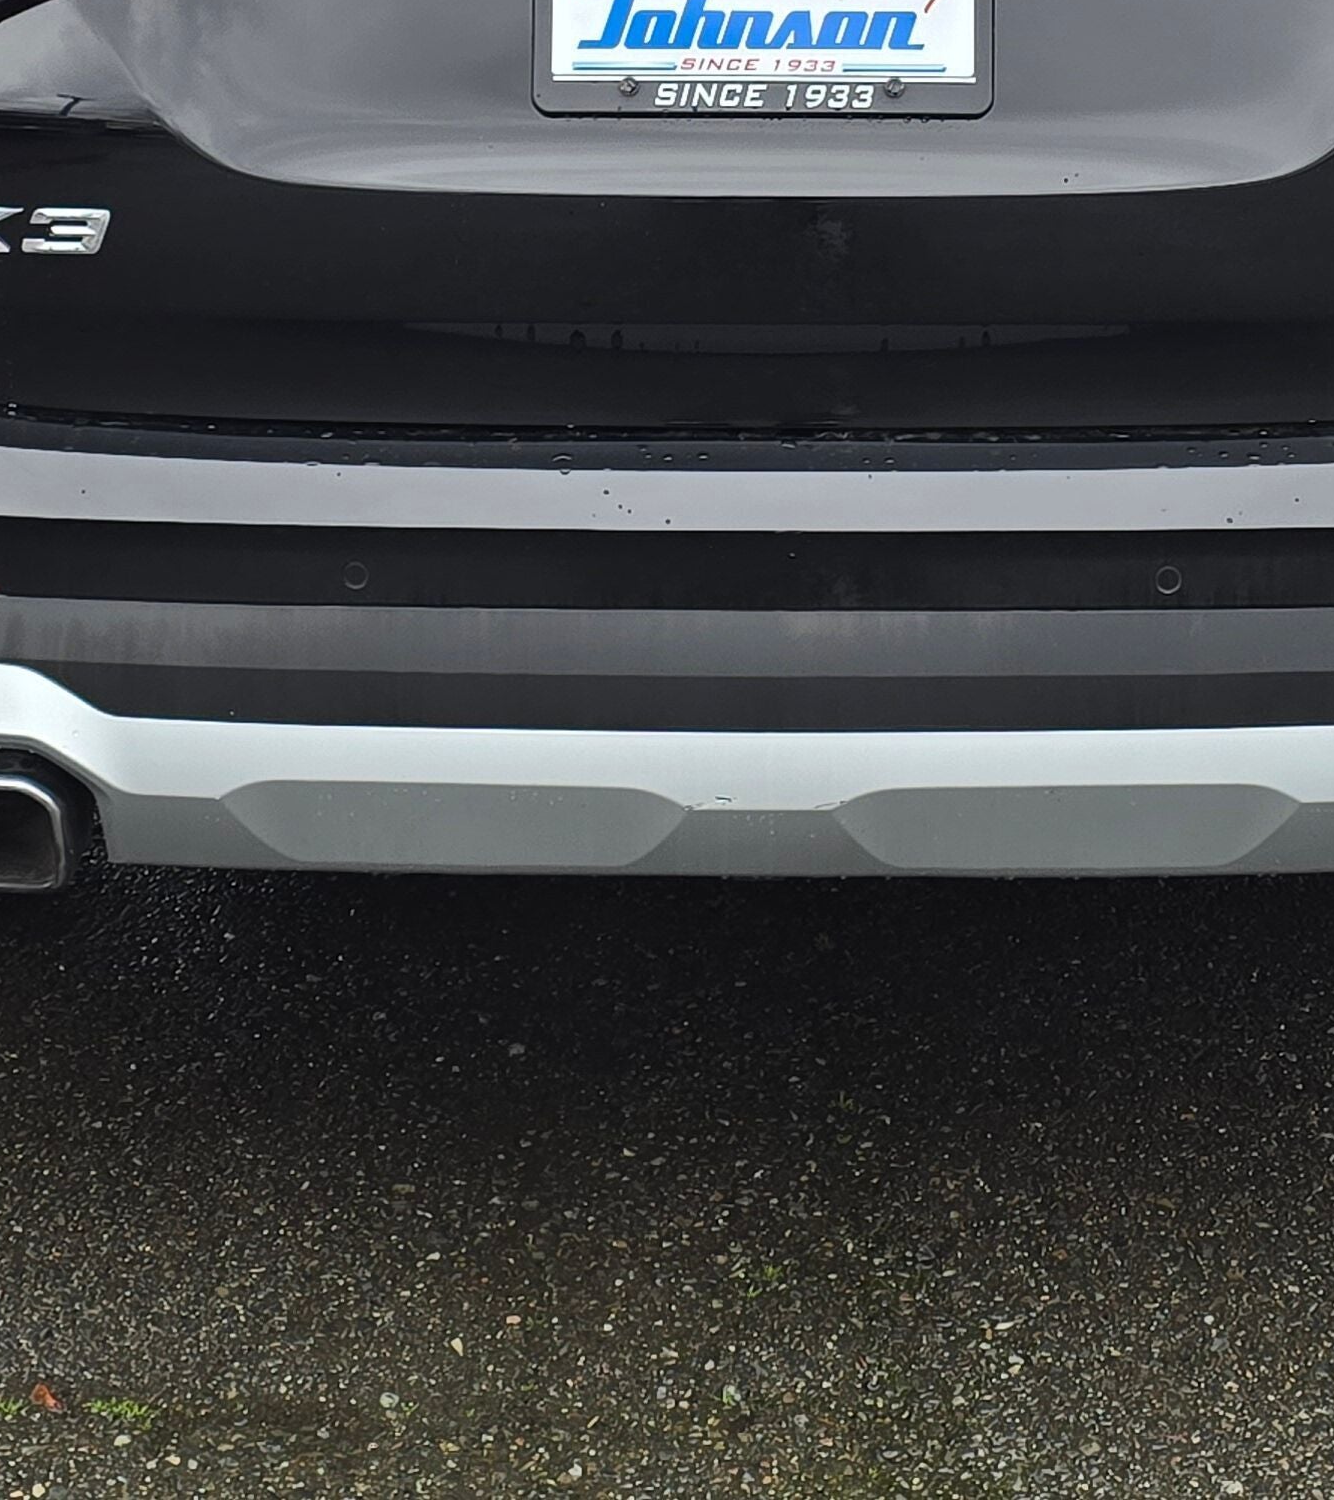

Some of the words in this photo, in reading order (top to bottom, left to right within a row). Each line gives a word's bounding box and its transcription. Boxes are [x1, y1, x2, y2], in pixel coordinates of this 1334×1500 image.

[680, 57, 760, 72] SINCE
[773, 58, 837, 73] 1933
[653, 82, 768, 108] SINCE
[785, 83, 875, 110] 1933
